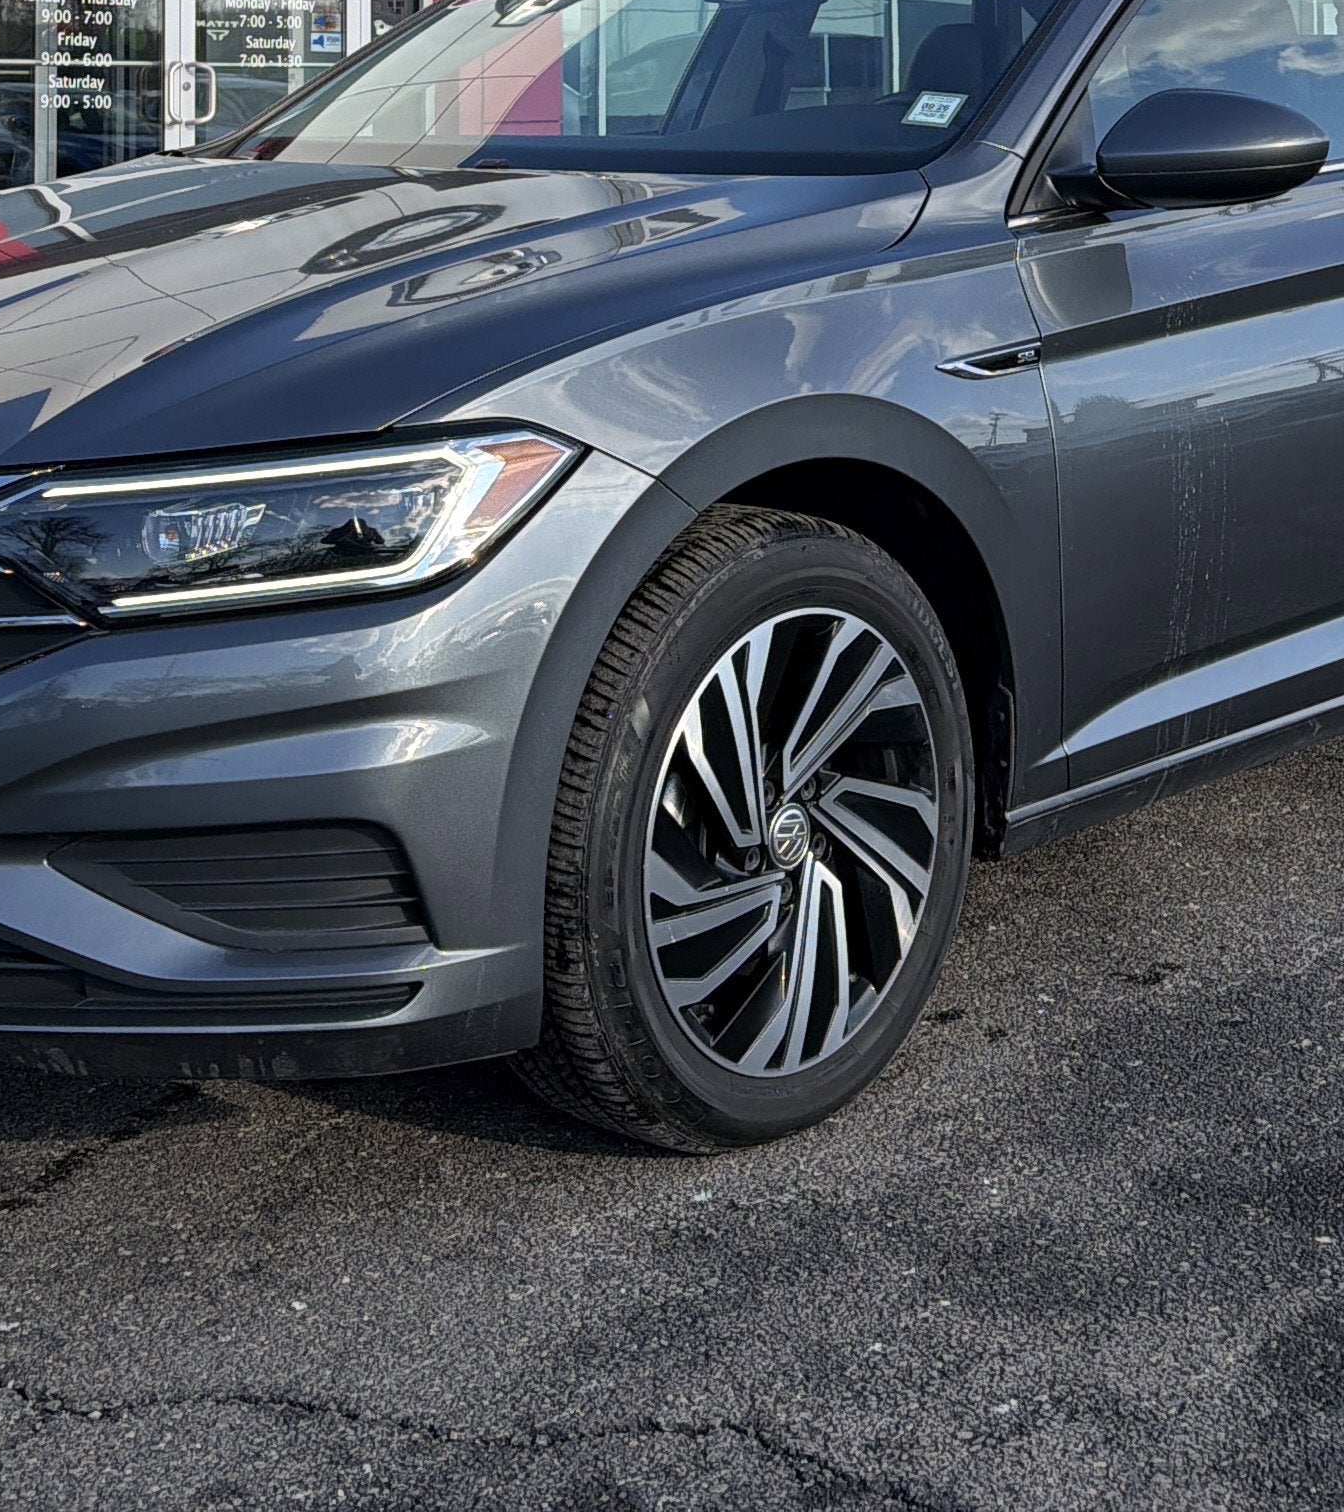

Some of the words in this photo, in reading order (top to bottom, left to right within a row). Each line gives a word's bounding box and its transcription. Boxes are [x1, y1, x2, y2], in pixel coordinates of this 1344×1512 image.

[41, 9, 72, 24] 9:00
[83, 10, 113, 25] 7:00
[239, 14, 266, 28] 7:00
[276, 15, 302, 29] 5:00
[57, 32, 98, 49] Friday
[245, 35, 297, 50] Saturday
[41, 51, 72, 66] 9:00
[82, 52, 113, 67] 6:00
[239, 54, 266, 68] 7:00
[277, 54, 303, 68] 1:30
[48, 74, 105, 92] Saturday
[40, 94, 71, 109] 9:00
[82, 95, 112, 110] 5:00
